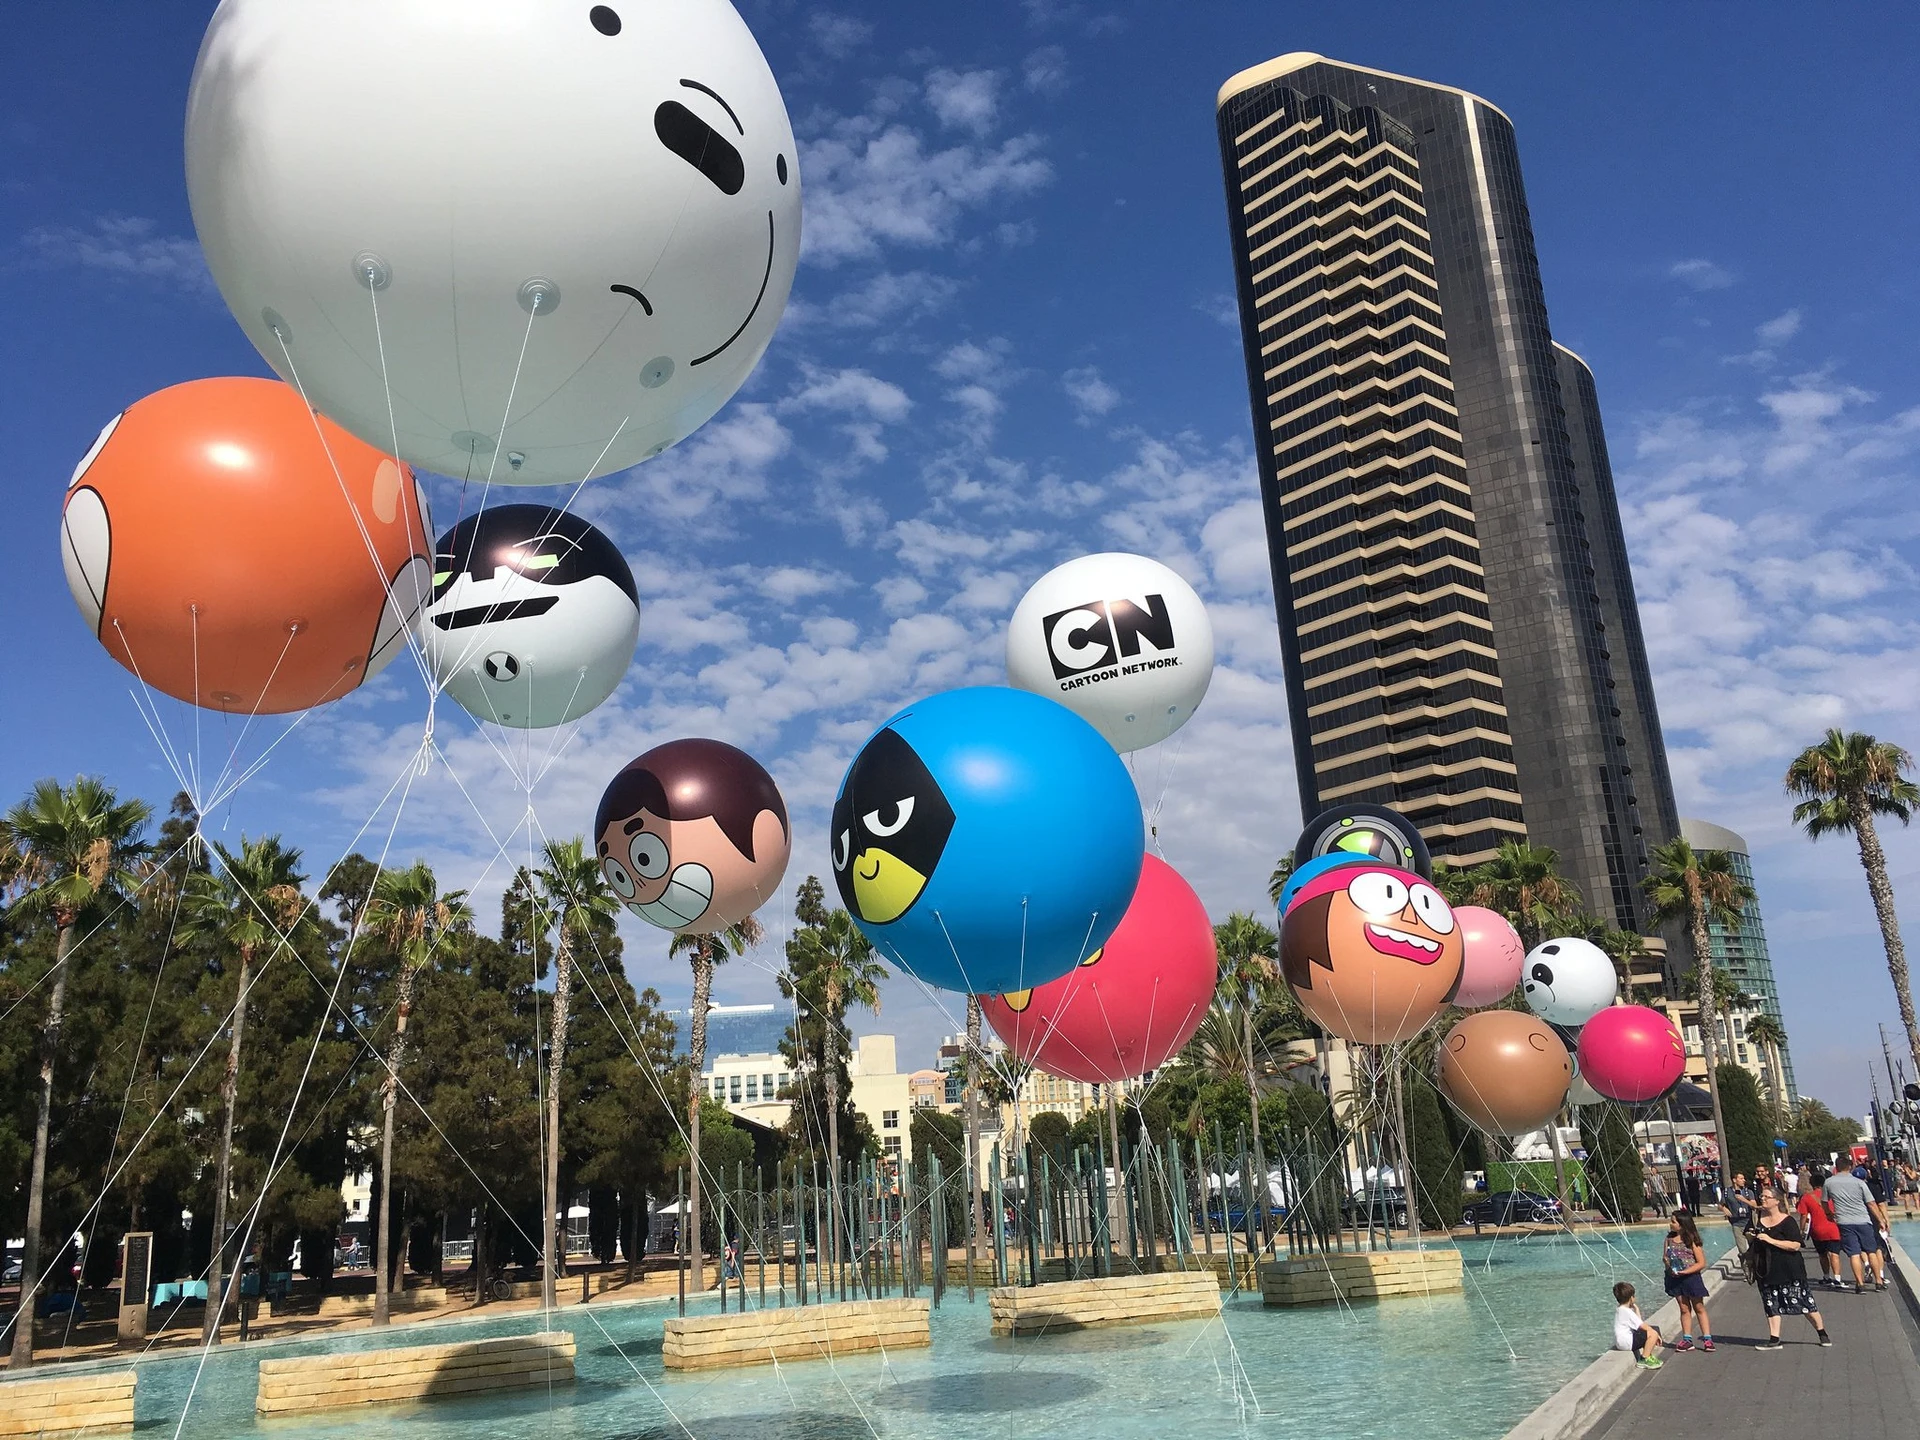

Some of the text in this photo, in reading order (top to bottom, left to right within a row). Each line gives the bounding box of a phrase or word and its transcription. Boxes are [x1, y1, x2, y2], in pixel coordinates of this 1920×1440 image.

[1043, 594, 1175, 680] CN
[1060, 657, 1178, 691] CARTOON NETWORK
